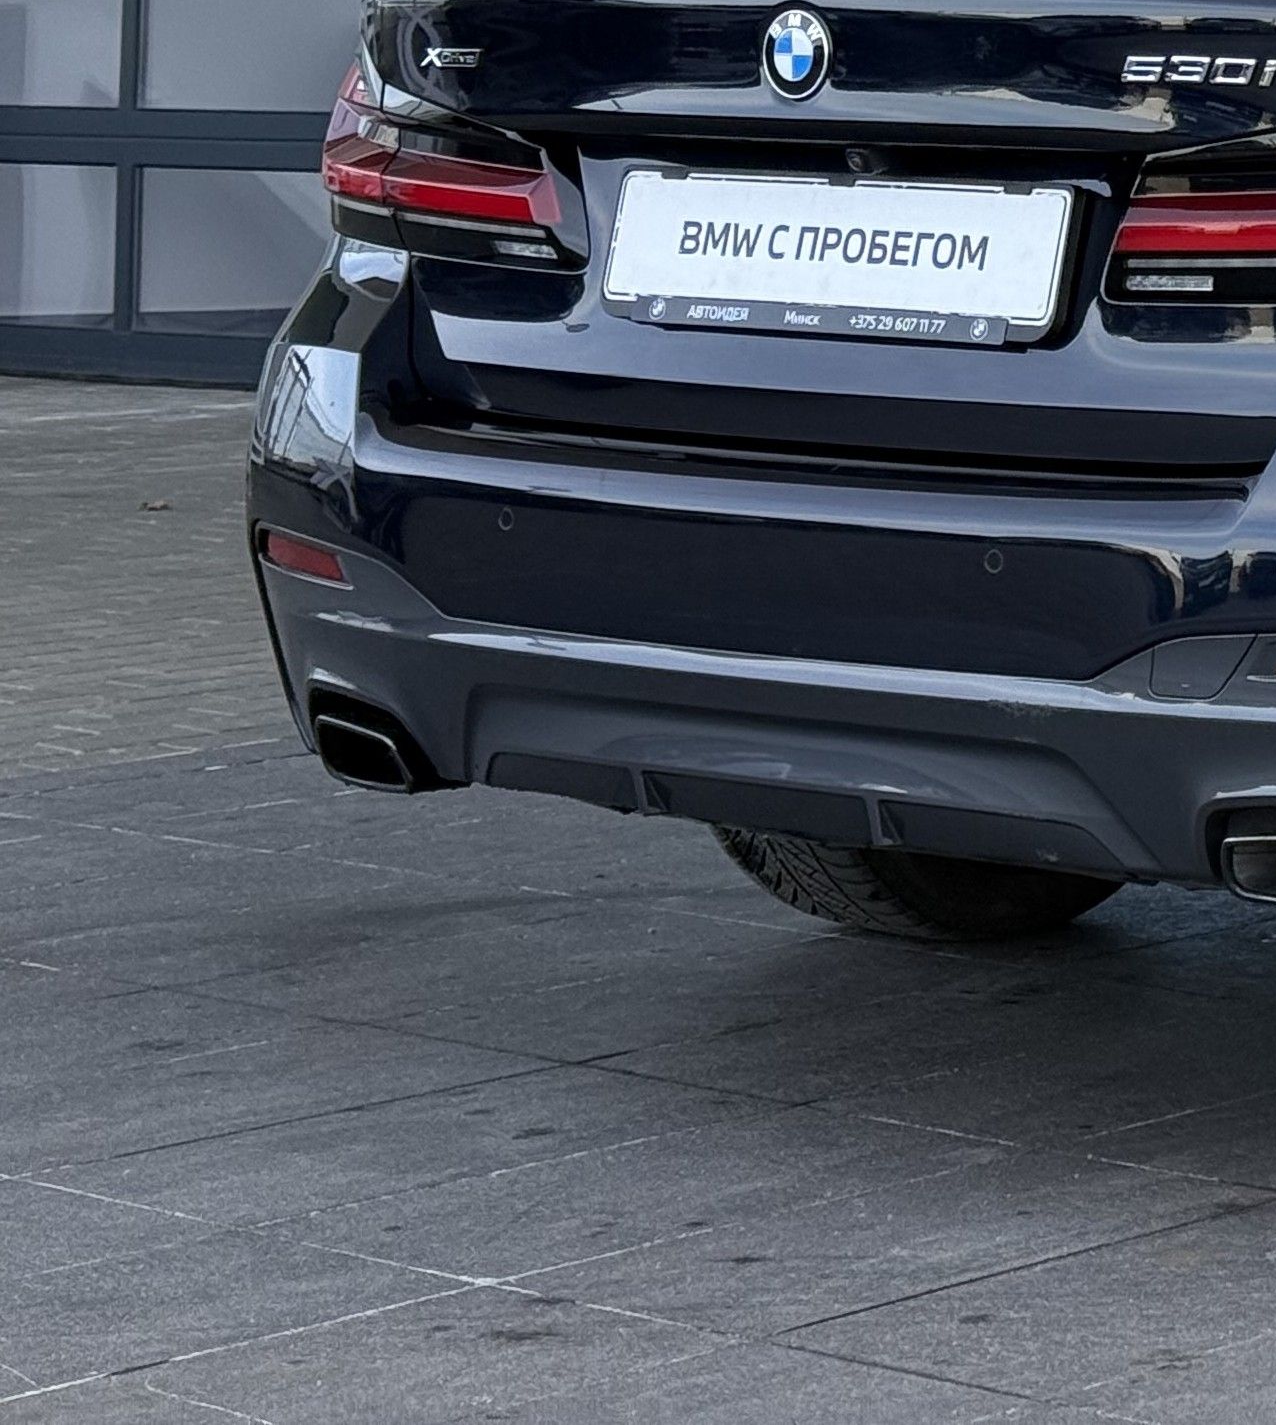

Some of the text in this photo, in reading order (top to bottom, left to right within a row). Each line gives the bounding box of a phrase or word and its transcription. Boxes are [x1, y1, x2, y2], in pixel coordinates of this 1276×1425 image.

[769, 13, 823, 42] BMW
[678, 220, 763, 258] BMW
[794, 226, 990, 271] ПРОБЕГОМ
[686, 304, 749, 322] АВТОИДЕЯ
[783, 309, 822, 326] Минск
[894, 317, 918, 332] 607
[929, 319, 947, 334] 77
